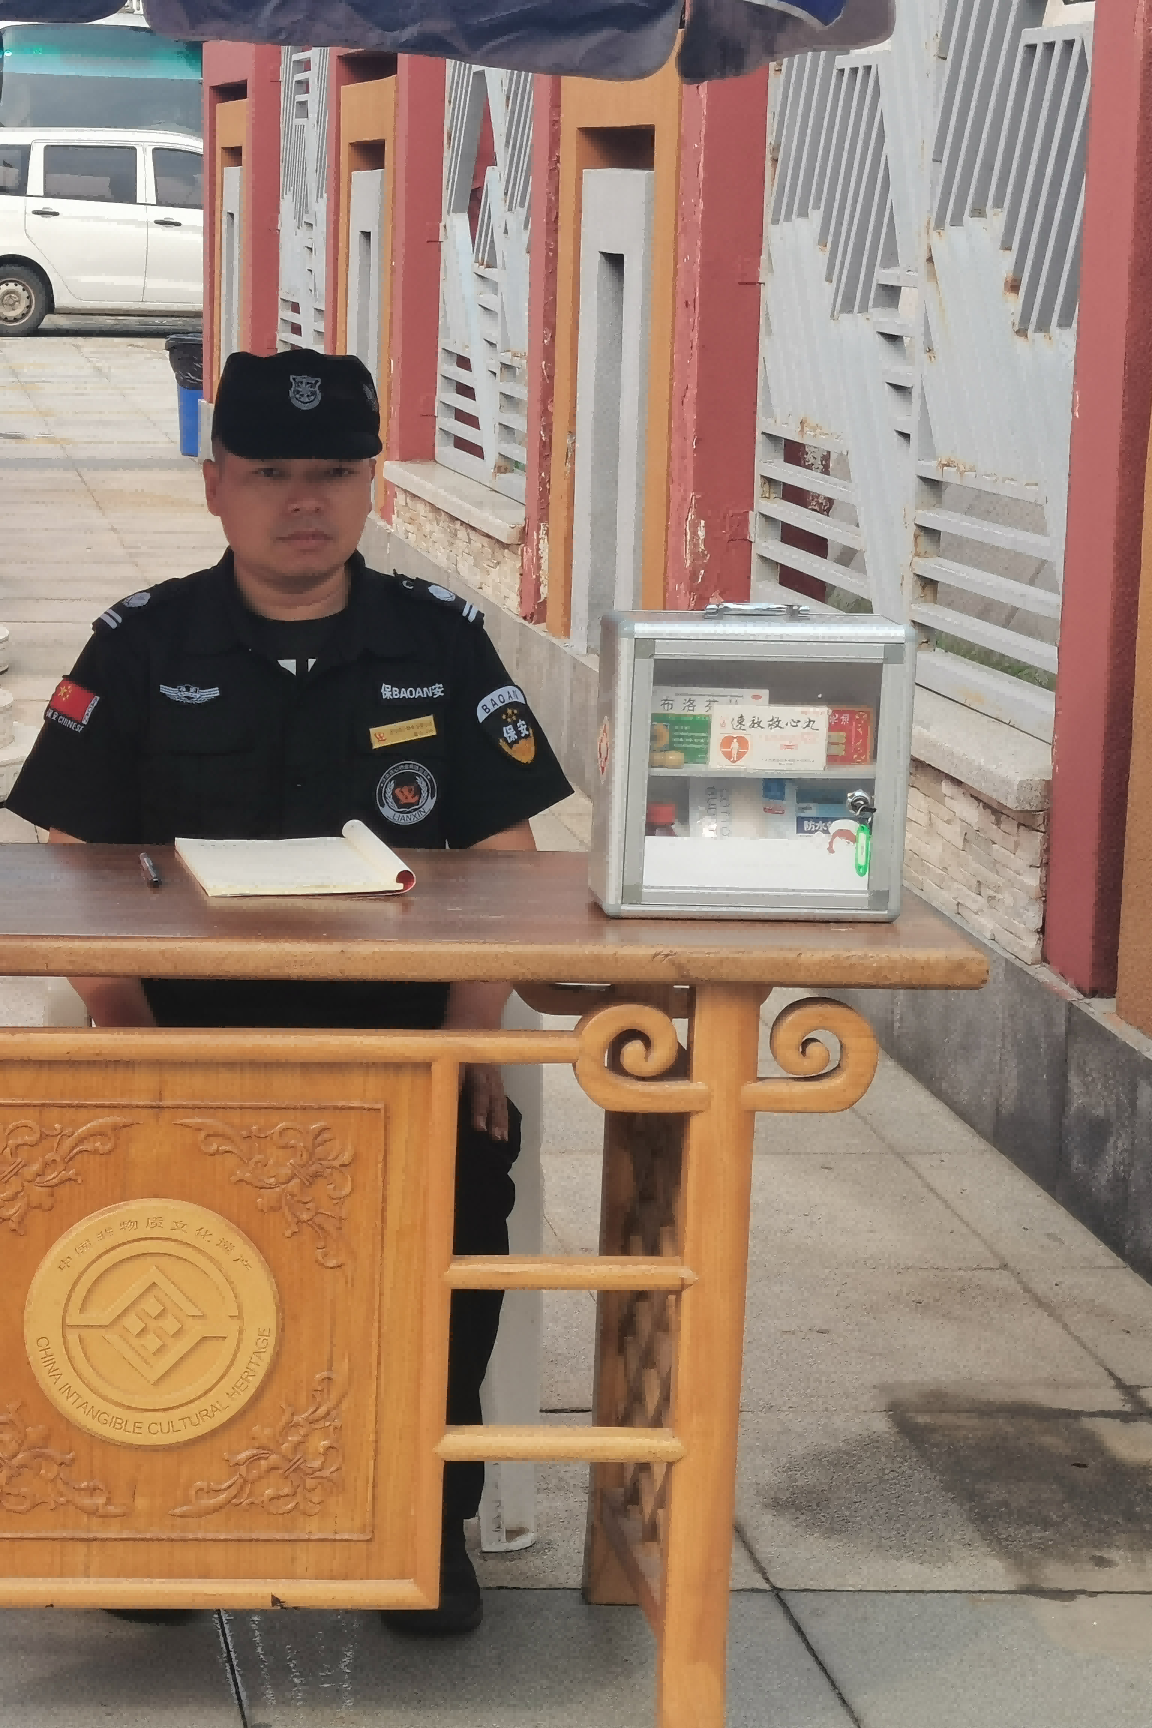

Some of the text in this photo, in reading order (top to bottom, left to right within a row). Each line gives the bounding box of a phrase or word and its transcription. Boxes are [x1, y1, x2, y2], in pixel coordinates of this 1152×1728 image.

[481, 690, 519, 714] BAOAN
[503, 719, 529, 743] 保安
[393, 808, 426, 822] LIANXIN
[57, 1215, 253, 1273] 中国非物质文化遗产
[35, 1326, 272, 1436] CHINA INTANGIBLE CULTURAL HERITAGE
